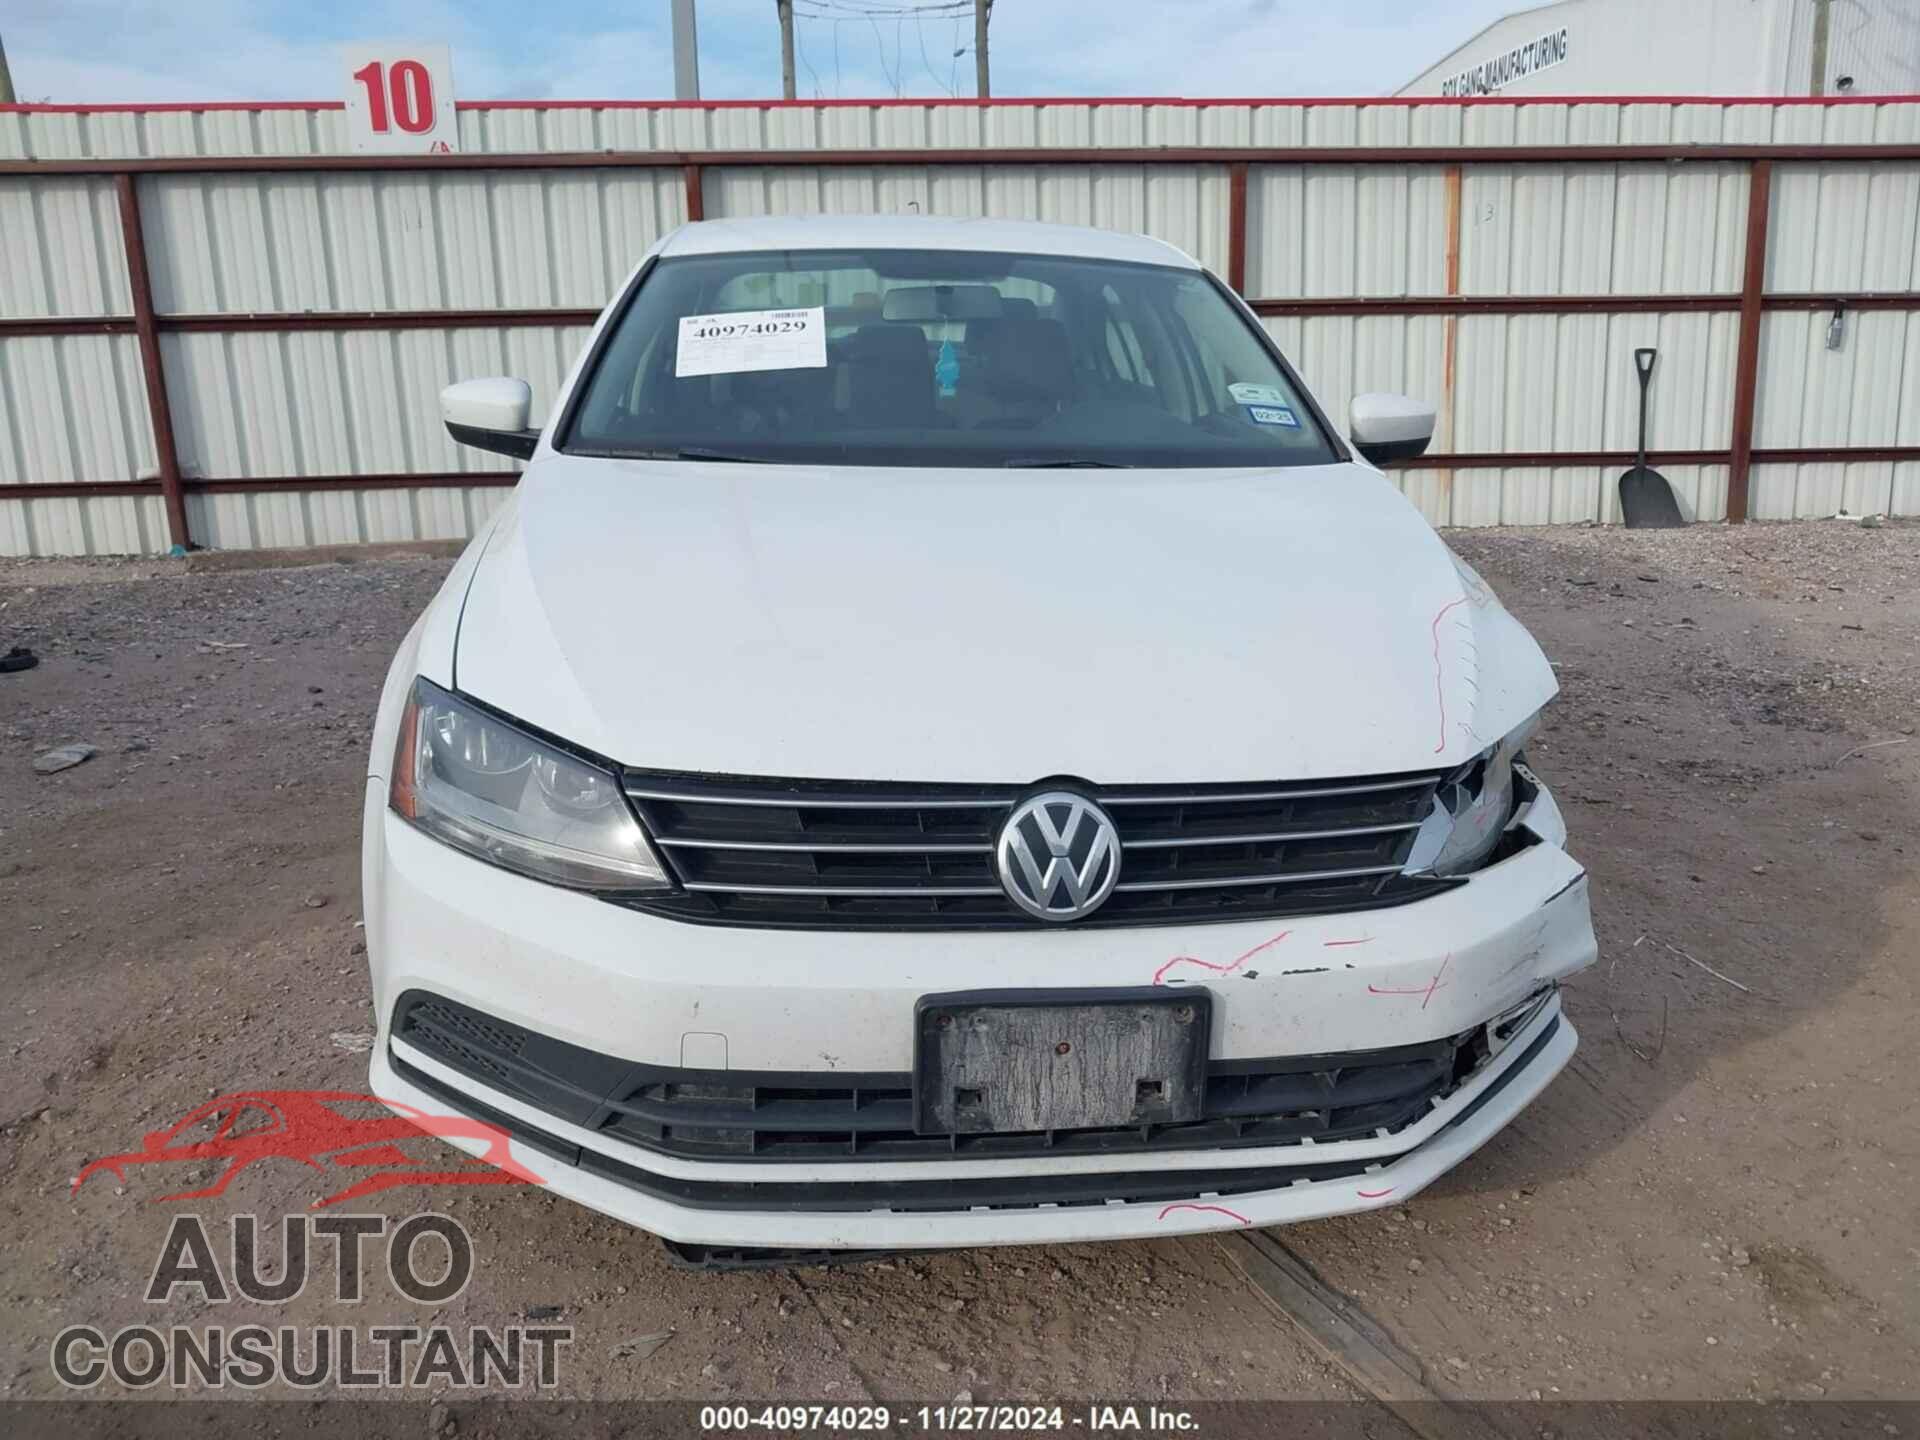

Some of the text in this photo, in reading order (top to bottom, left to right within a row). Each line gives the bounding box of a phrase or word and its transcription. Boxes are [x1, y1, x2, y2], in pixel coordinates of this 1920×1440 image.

[1486, 28, 1567, 91] MANUFACTURING
[353, 59, 436, 134] 10
[693, 320, 807, 339] 40974029
[1000, 794, 1118, 917] VW
